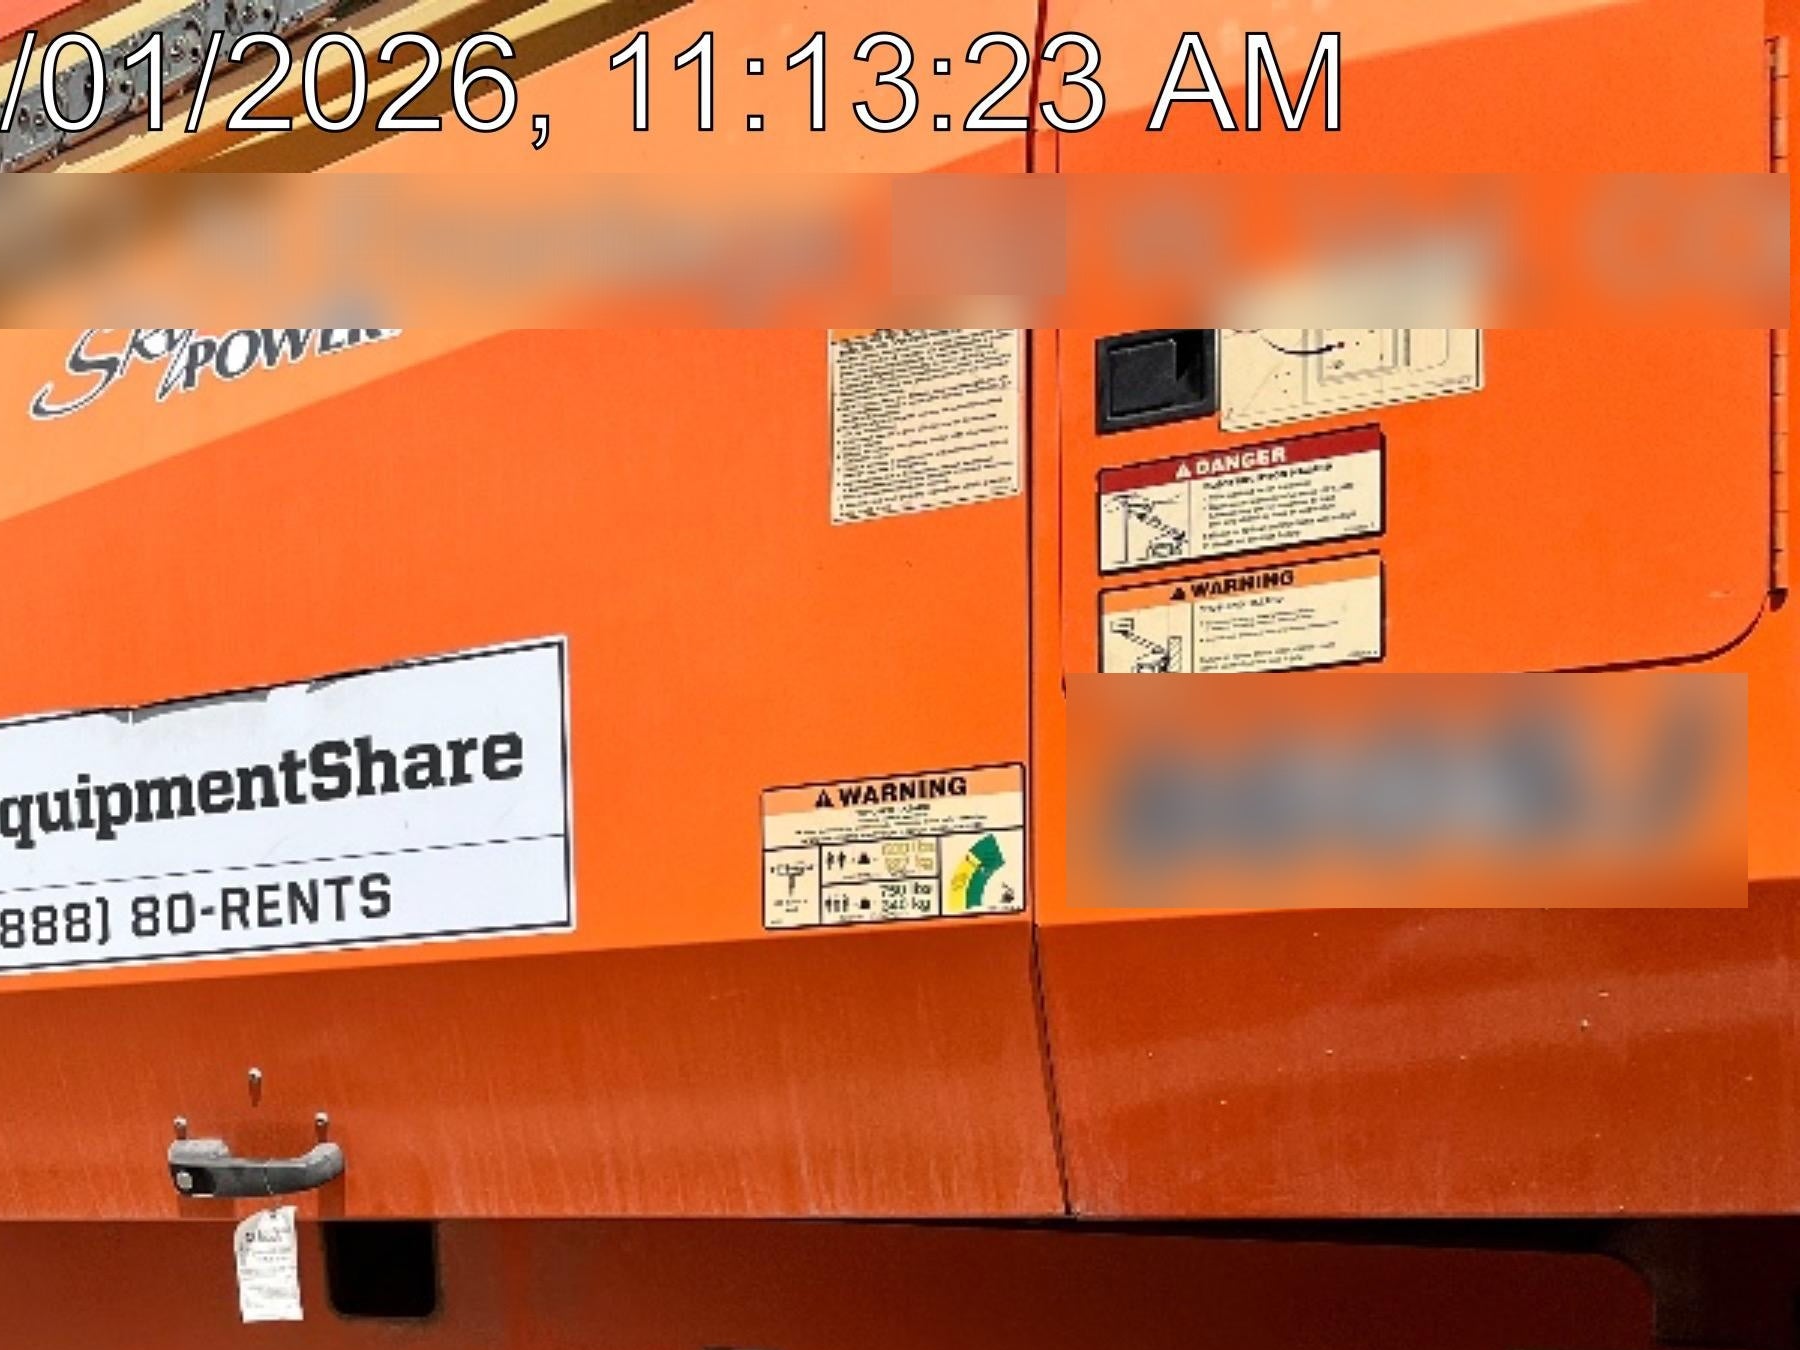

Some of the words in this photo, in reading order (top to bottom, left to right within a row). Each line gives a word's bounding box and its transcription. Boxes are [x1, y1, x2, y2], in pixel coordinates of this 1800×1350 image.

[1196, 446, 1287, 476] DANGER
[1191, 569, 1294, 598] WARNING
[839, 777, 967, 808] WARNING
[131, 872, 393, 938] 80-RENTS
